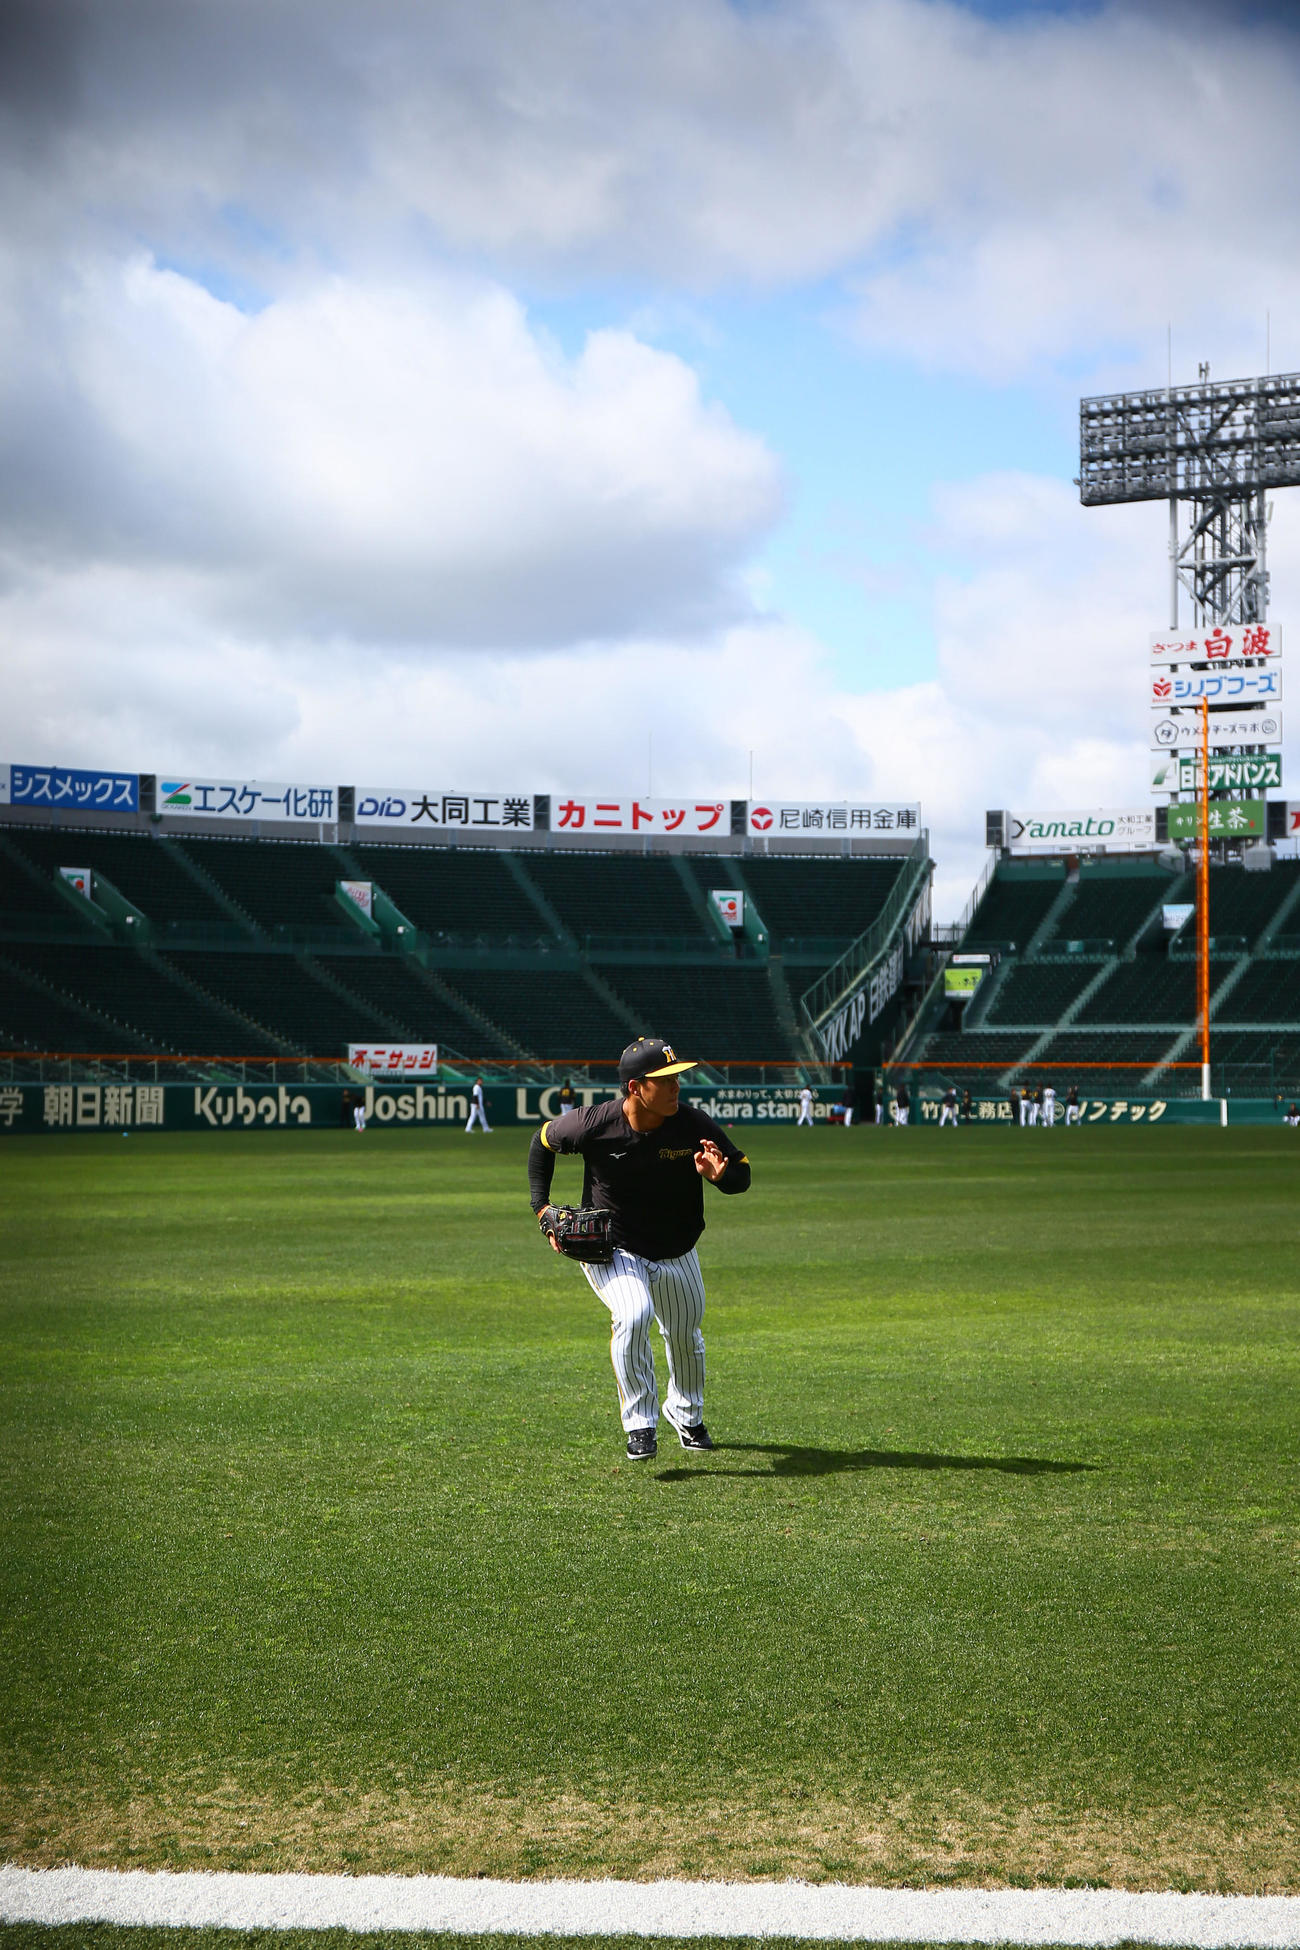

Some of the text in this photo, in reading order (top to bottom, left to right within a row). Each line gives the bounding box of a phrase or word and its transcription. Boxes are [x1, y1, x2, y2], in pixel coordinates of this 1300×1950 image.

[1174, 672, 1277, 698] シノブフーズ
[1181, 723, 1260, 736] ウメチーズラボ
[13, 770, 134, 806] シスメックス
[193, 782, 333, 820] エスケー化研
[411, 794, 531, 828] 大同工業
[558, 799, 725, 832] カニトップ
[778, 807, 917, 830] 尼崎信用金庫
[43, 1085, 165, 1126] 朝日新聞
[194, 1086, 311, 1125] Kubota
[362, 1086, 469, 1121] Joshin
[688, 1097, 754, 1119] Takara
